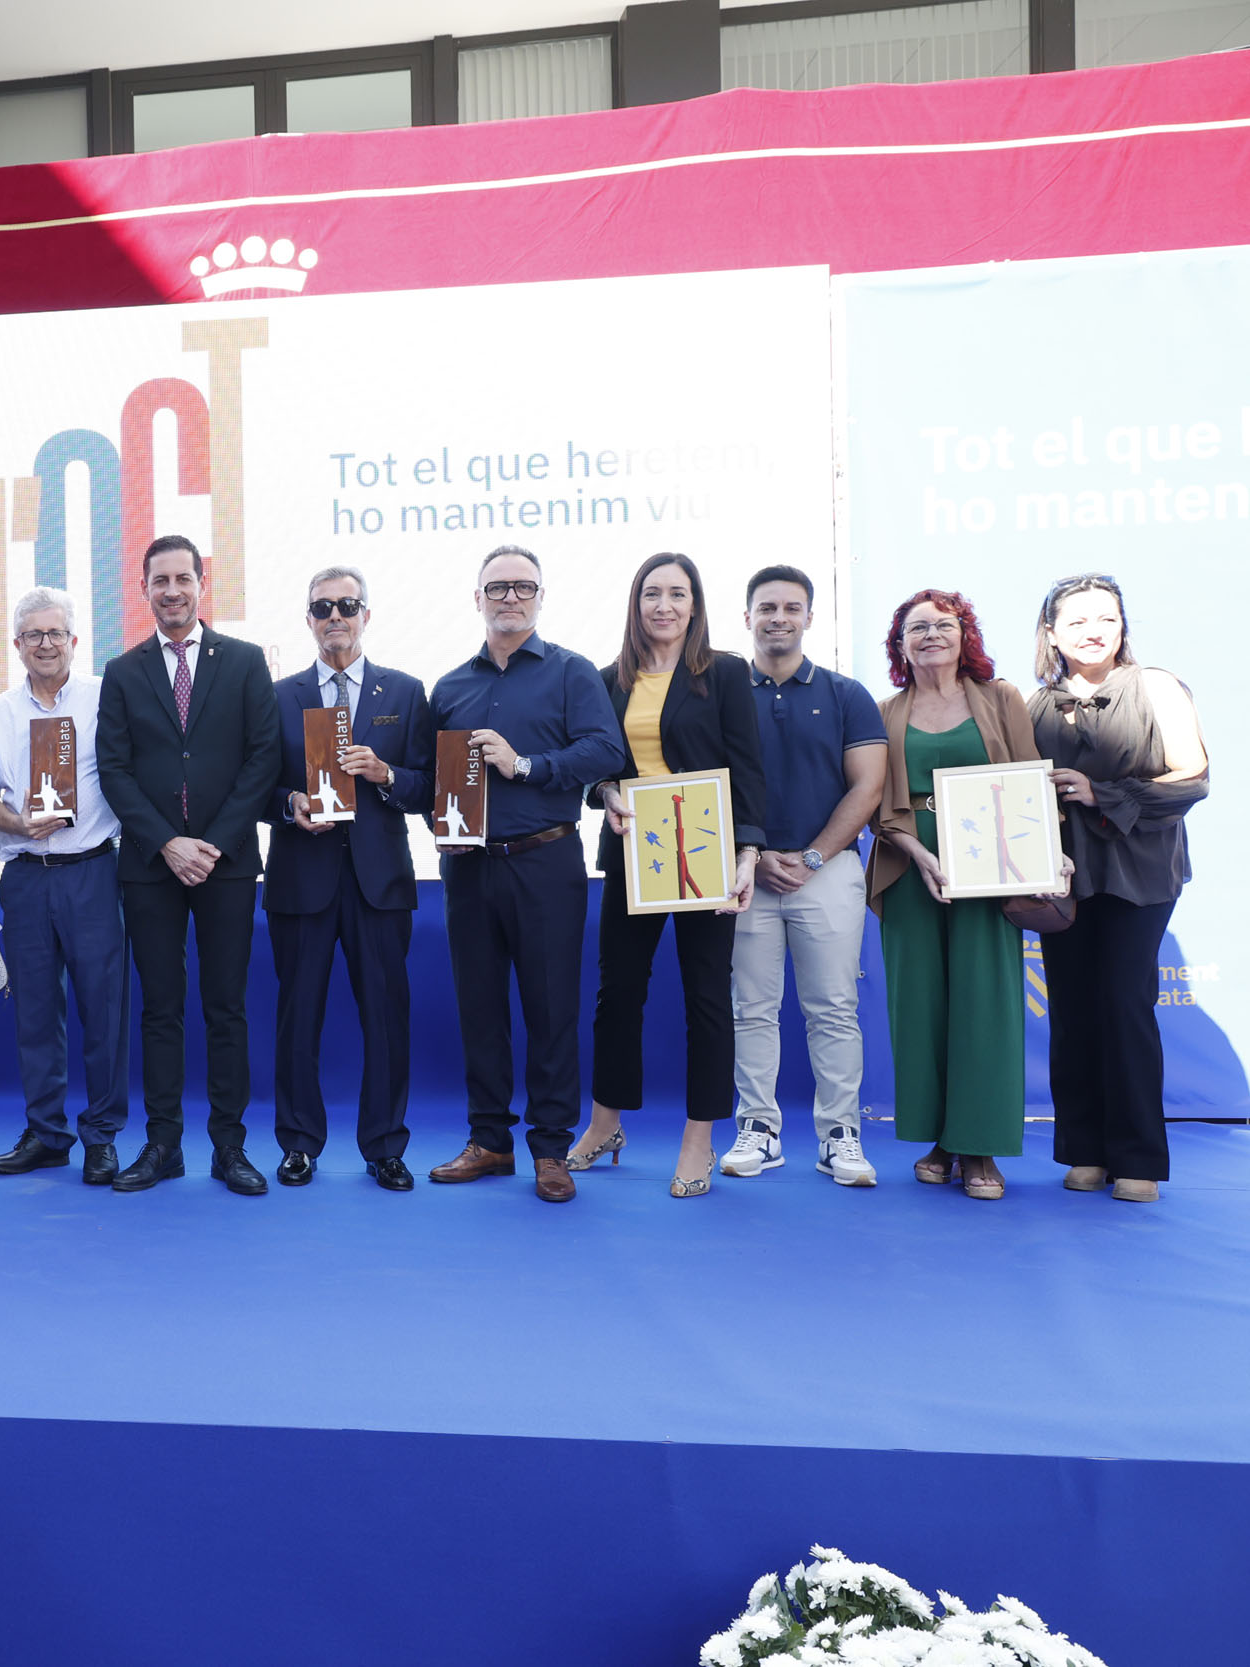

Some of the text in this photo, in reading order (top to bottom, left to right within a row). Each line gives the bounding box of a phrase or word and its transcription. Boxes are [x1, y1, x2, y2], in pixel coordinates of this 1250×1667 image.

[330, 448, 397, 488] Tot
[413, 446, 452, 484] el
[467, 451, 550, 491] que
[919, 425, 1015, 473] Tot
[1033, 415, 1089, 468] el
[1106, 421, 1221, 475] que
[333, 498, 384, 535] ho
[400, 488, 630, 532] mantenim
[923, 477, 1250, 535] ho manten
[59, 720, 71, 766] Mislata
[466, 737, 480, 786] Misla
[1158, 962, 1221, 981] ment
